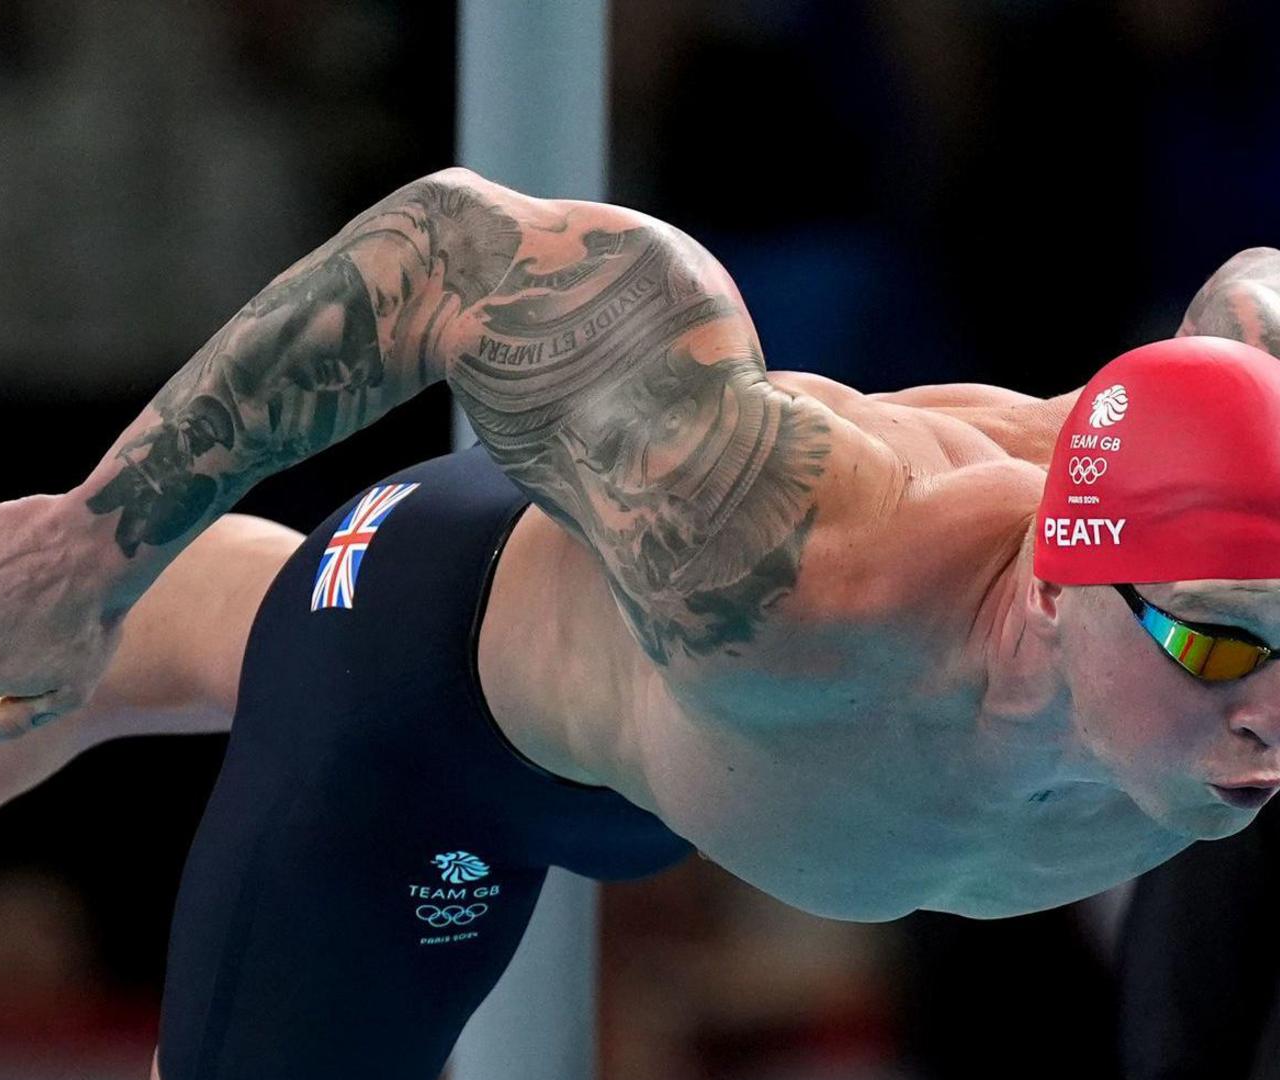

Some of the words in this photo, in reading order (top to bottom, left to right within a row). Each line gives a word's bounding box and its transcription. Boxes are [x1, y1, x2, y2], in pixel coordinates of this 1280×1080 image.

[582, 275, 657, 342] DIVIDE
[479, 335, 544, 366] IMPERA
[548, 330, 577, 358] ET
[1070, 434, 1098, 449] TEAM
[1100, 436, 1121, 451] GB
[1044, 517, 1126, 547] PEATY
[409, 884, 467, 900] TEAM
[473, 884, 500, 898] GB
